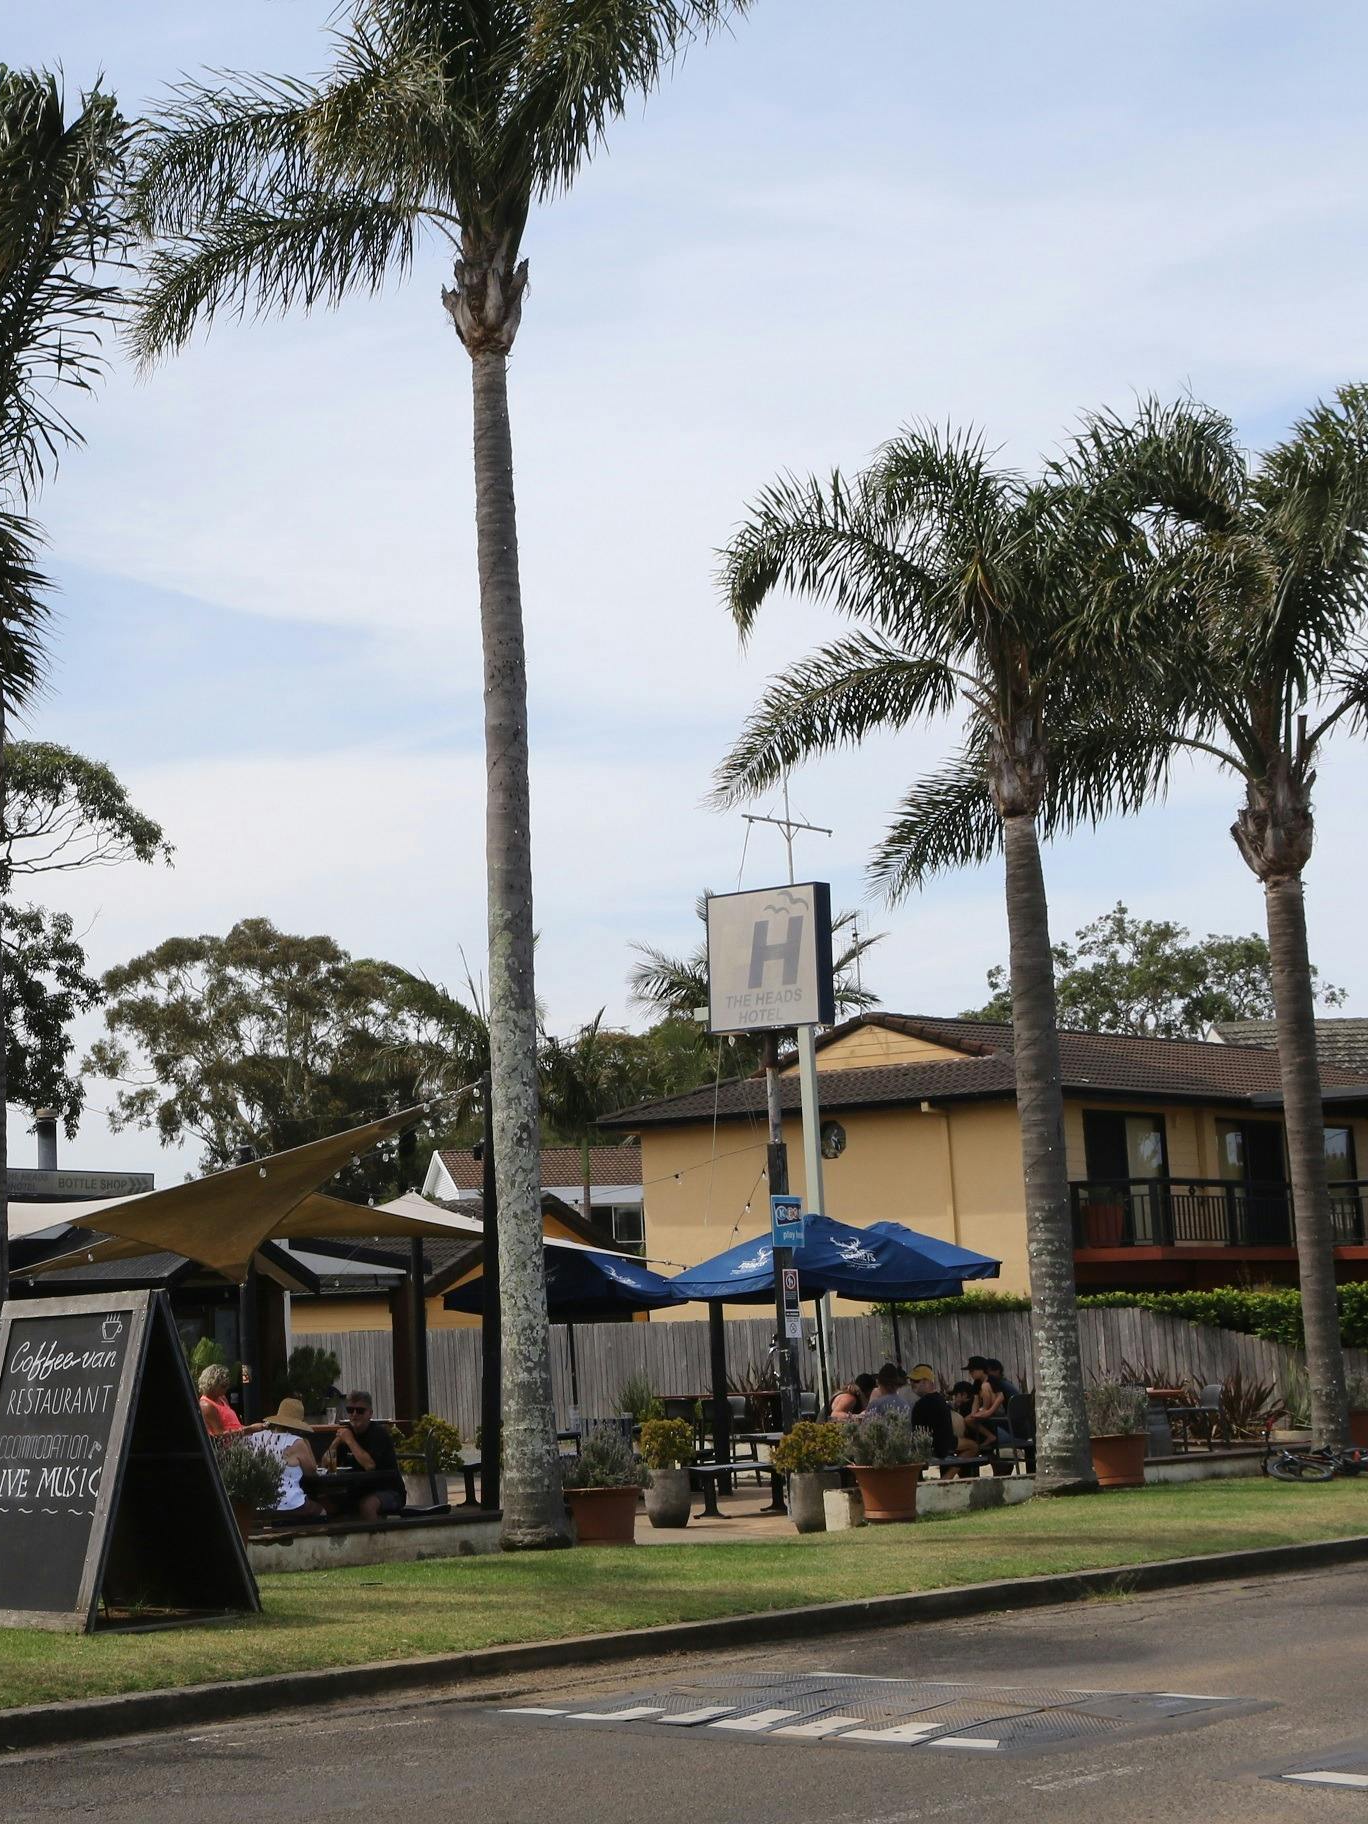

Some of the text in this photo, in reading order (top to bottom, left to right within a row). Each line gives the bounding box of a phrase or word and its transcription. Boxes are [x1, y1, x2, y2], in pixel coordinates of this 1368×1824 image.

[725, 989, 802, 1009] THE HEADS
[738, 1008, 783, 1024] HOTEL
[58, 1177, 128, 1191] BOTTLE SHOP
[10, 1340, 117, 1381] Coffee van
[6, 1385, 114, 1416] RESTAURANT
[35, 1465, 103, 1498] MUSIC
